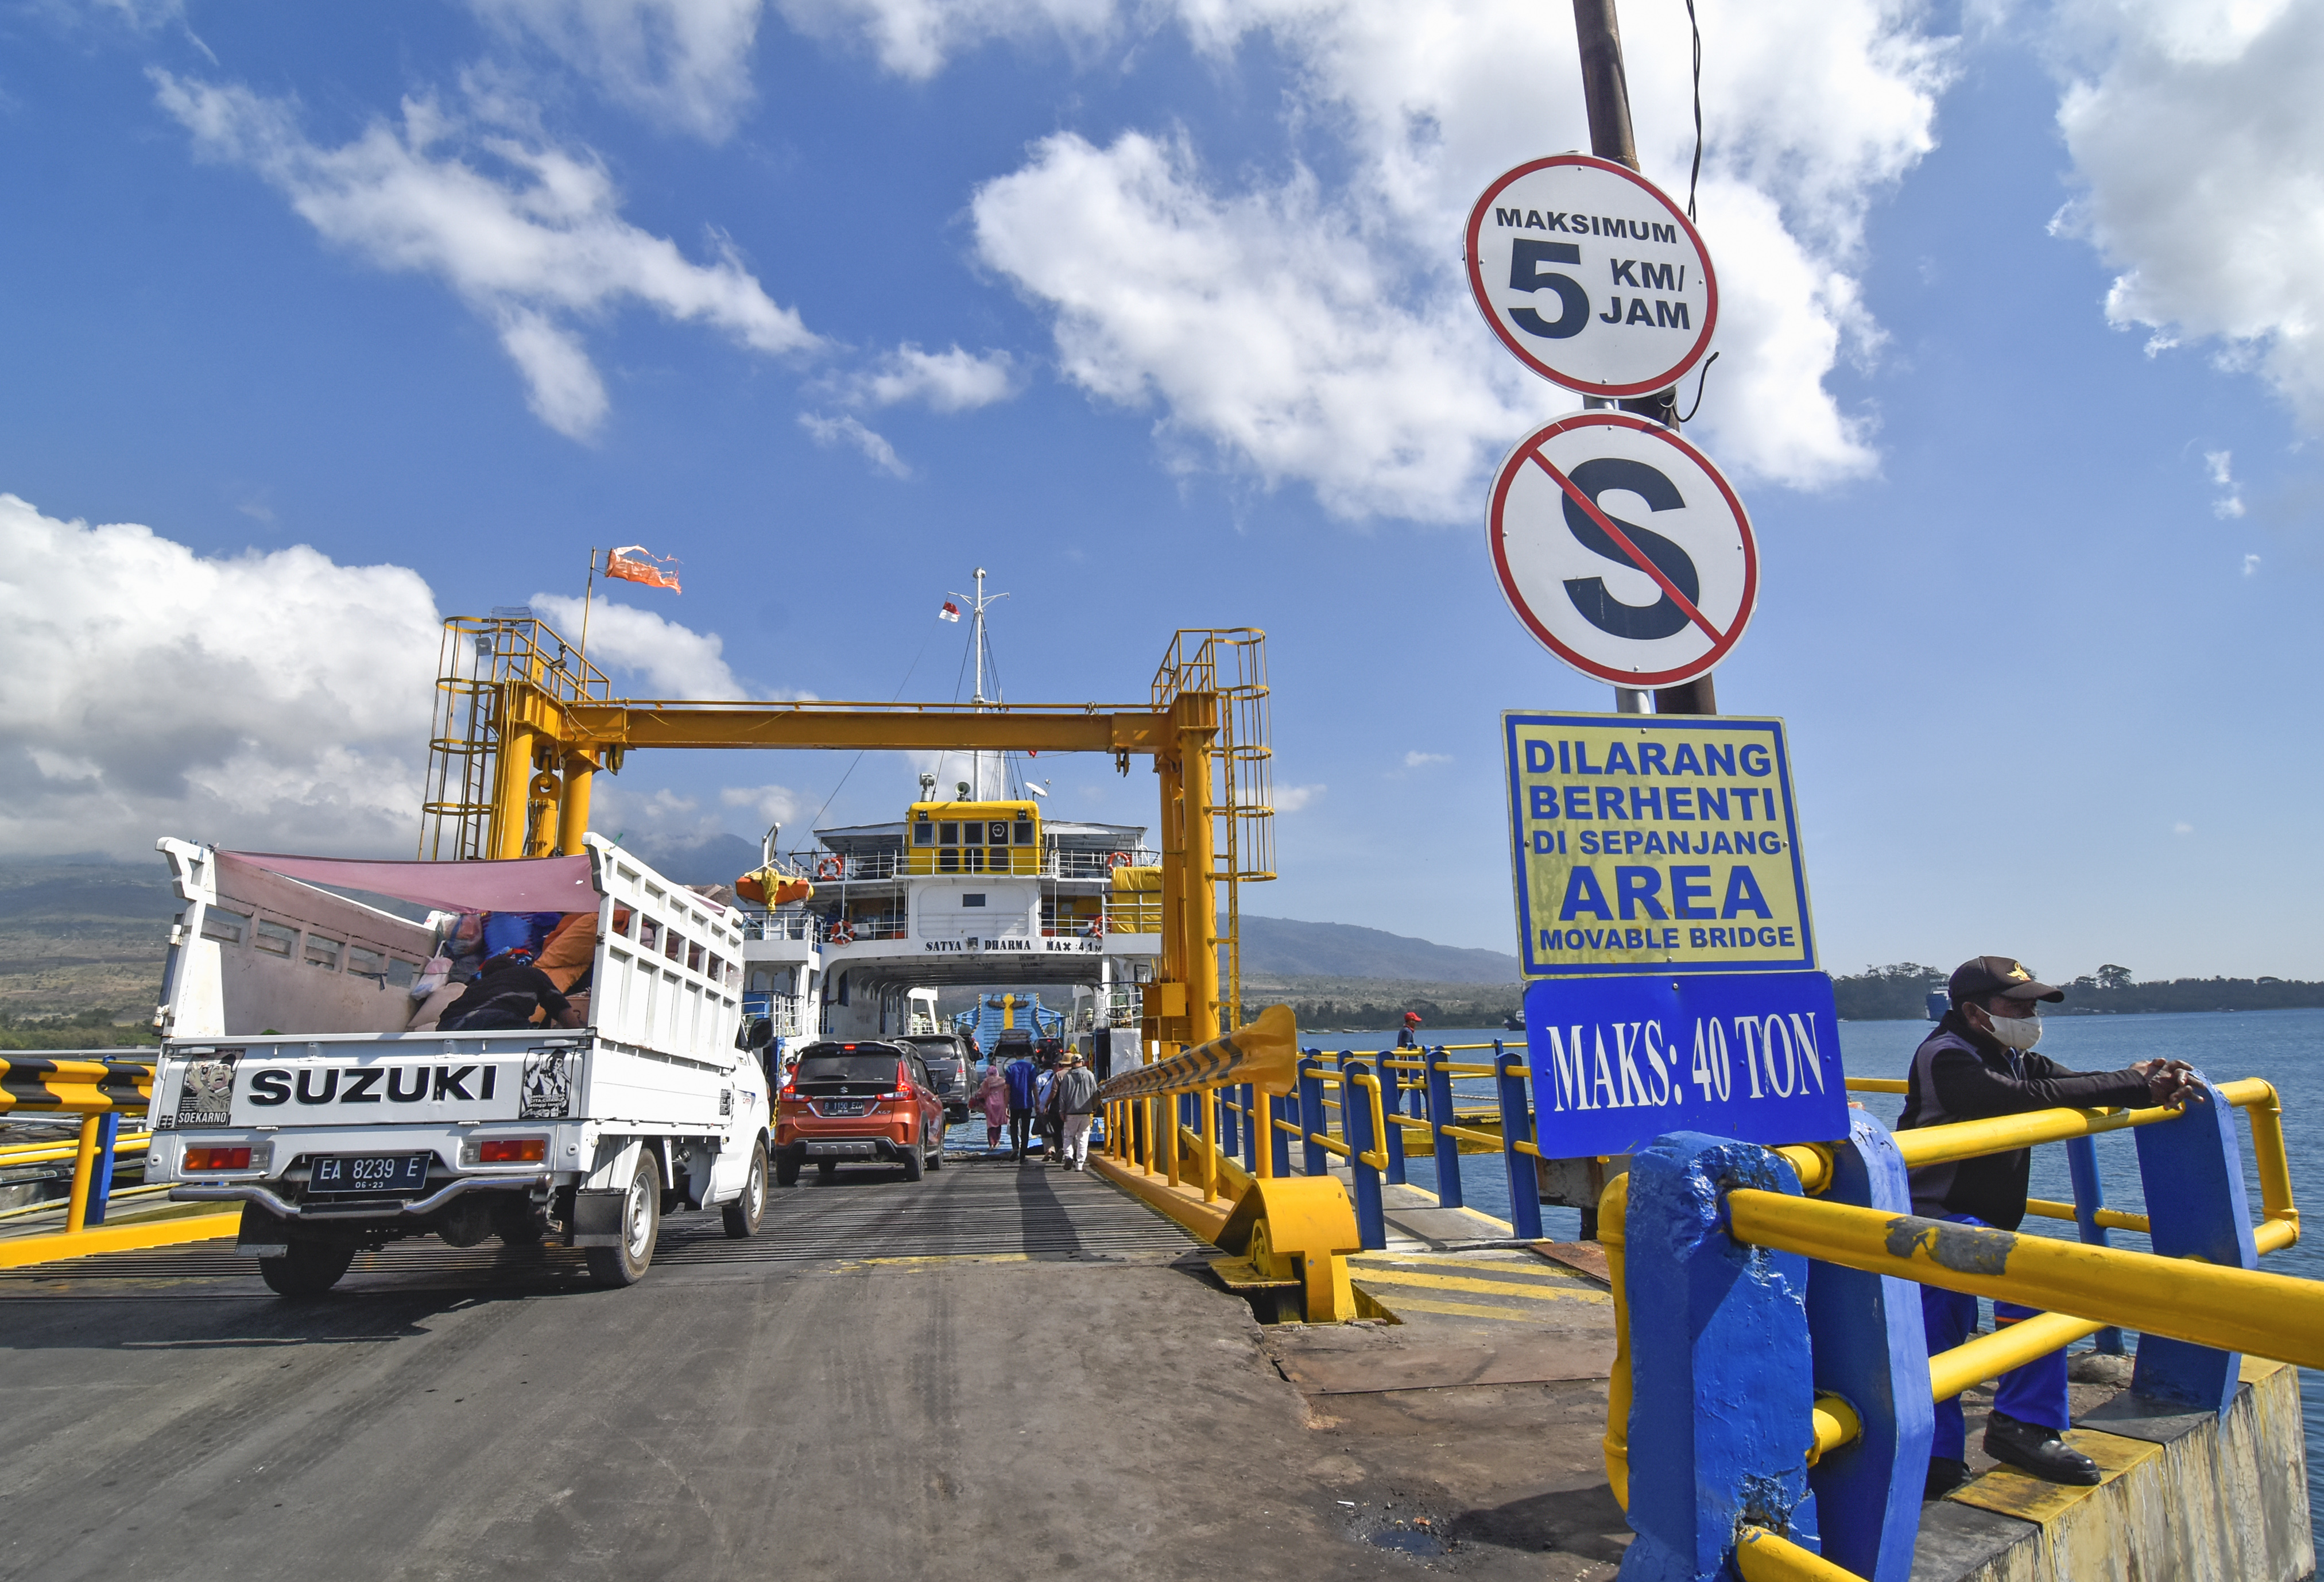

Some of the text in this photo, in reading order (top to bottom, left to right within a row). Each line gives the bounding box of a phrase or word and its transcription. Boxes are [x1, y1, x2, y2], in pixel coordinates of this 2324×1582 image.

[1496, 207, 1677, 244] MAKSIMUM
[1508, 238, 1686, 339] 5 KM/
[1599, 296, 1691, 330] JAM
[1562, 457, 1700, 640] S
[1524, 739, 1772, 777] DILARANG
[1528, 785, 1777, 821] BERHENTI
[1533, 830, 1781, 856] DI SEPANJANG
[1558, 865, 1773, 922] AREA
[925, 939, 1031, 951] SATYA DHARMA
[1046, 941, 1072, 951] MAX
[1540, 926, 1796, 951] MOVABLE BRIDGE
[1546, 1012, 1825, 1112] MAKS: 40 TON
[248, 1064, 498, 1106] SUZUKI
[178, 1112, 227, 1123] SOEKARNO
[320, 1158, 420, 1179] EA 8239 E
